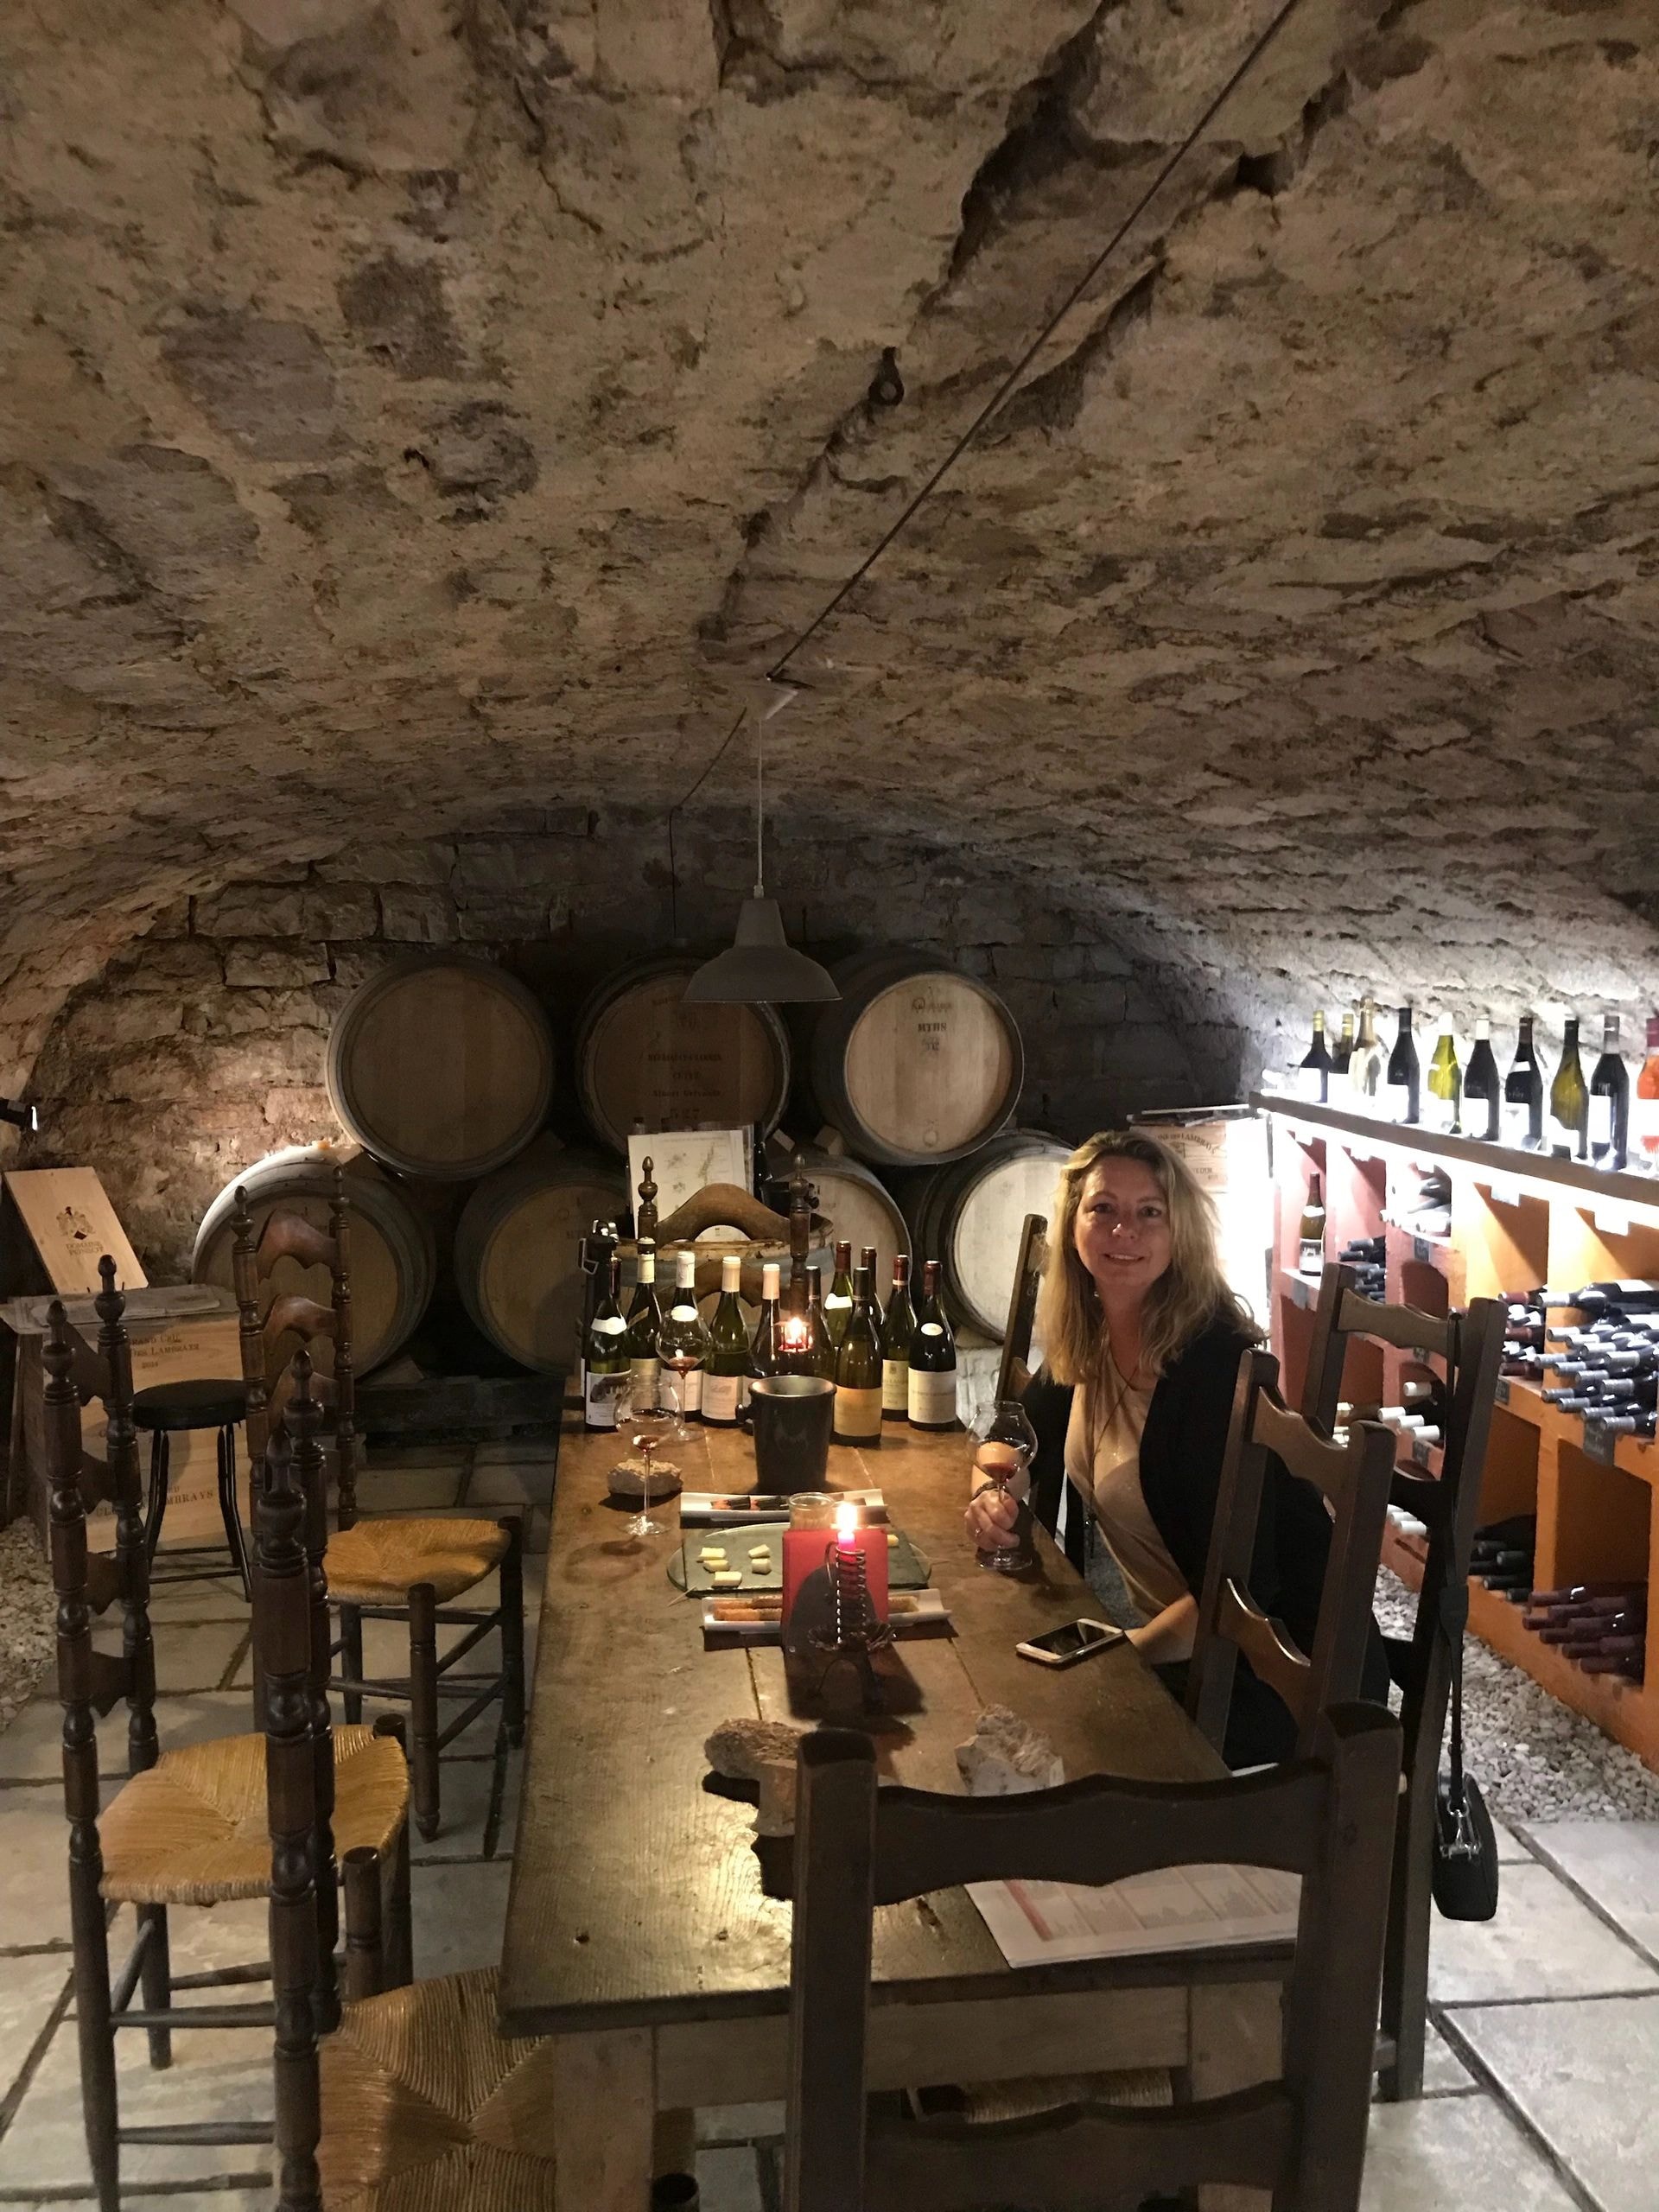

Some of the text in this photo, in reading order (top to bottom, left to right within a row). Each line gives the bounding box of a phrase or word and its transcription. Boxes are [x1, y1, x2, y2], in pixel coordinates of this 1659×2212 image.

[130, 1337, 157, 1345] RAND
[150, 1344, 200, 1356] LAMBRAYS
[166, 1490, 214, 1505] MBRAYS
